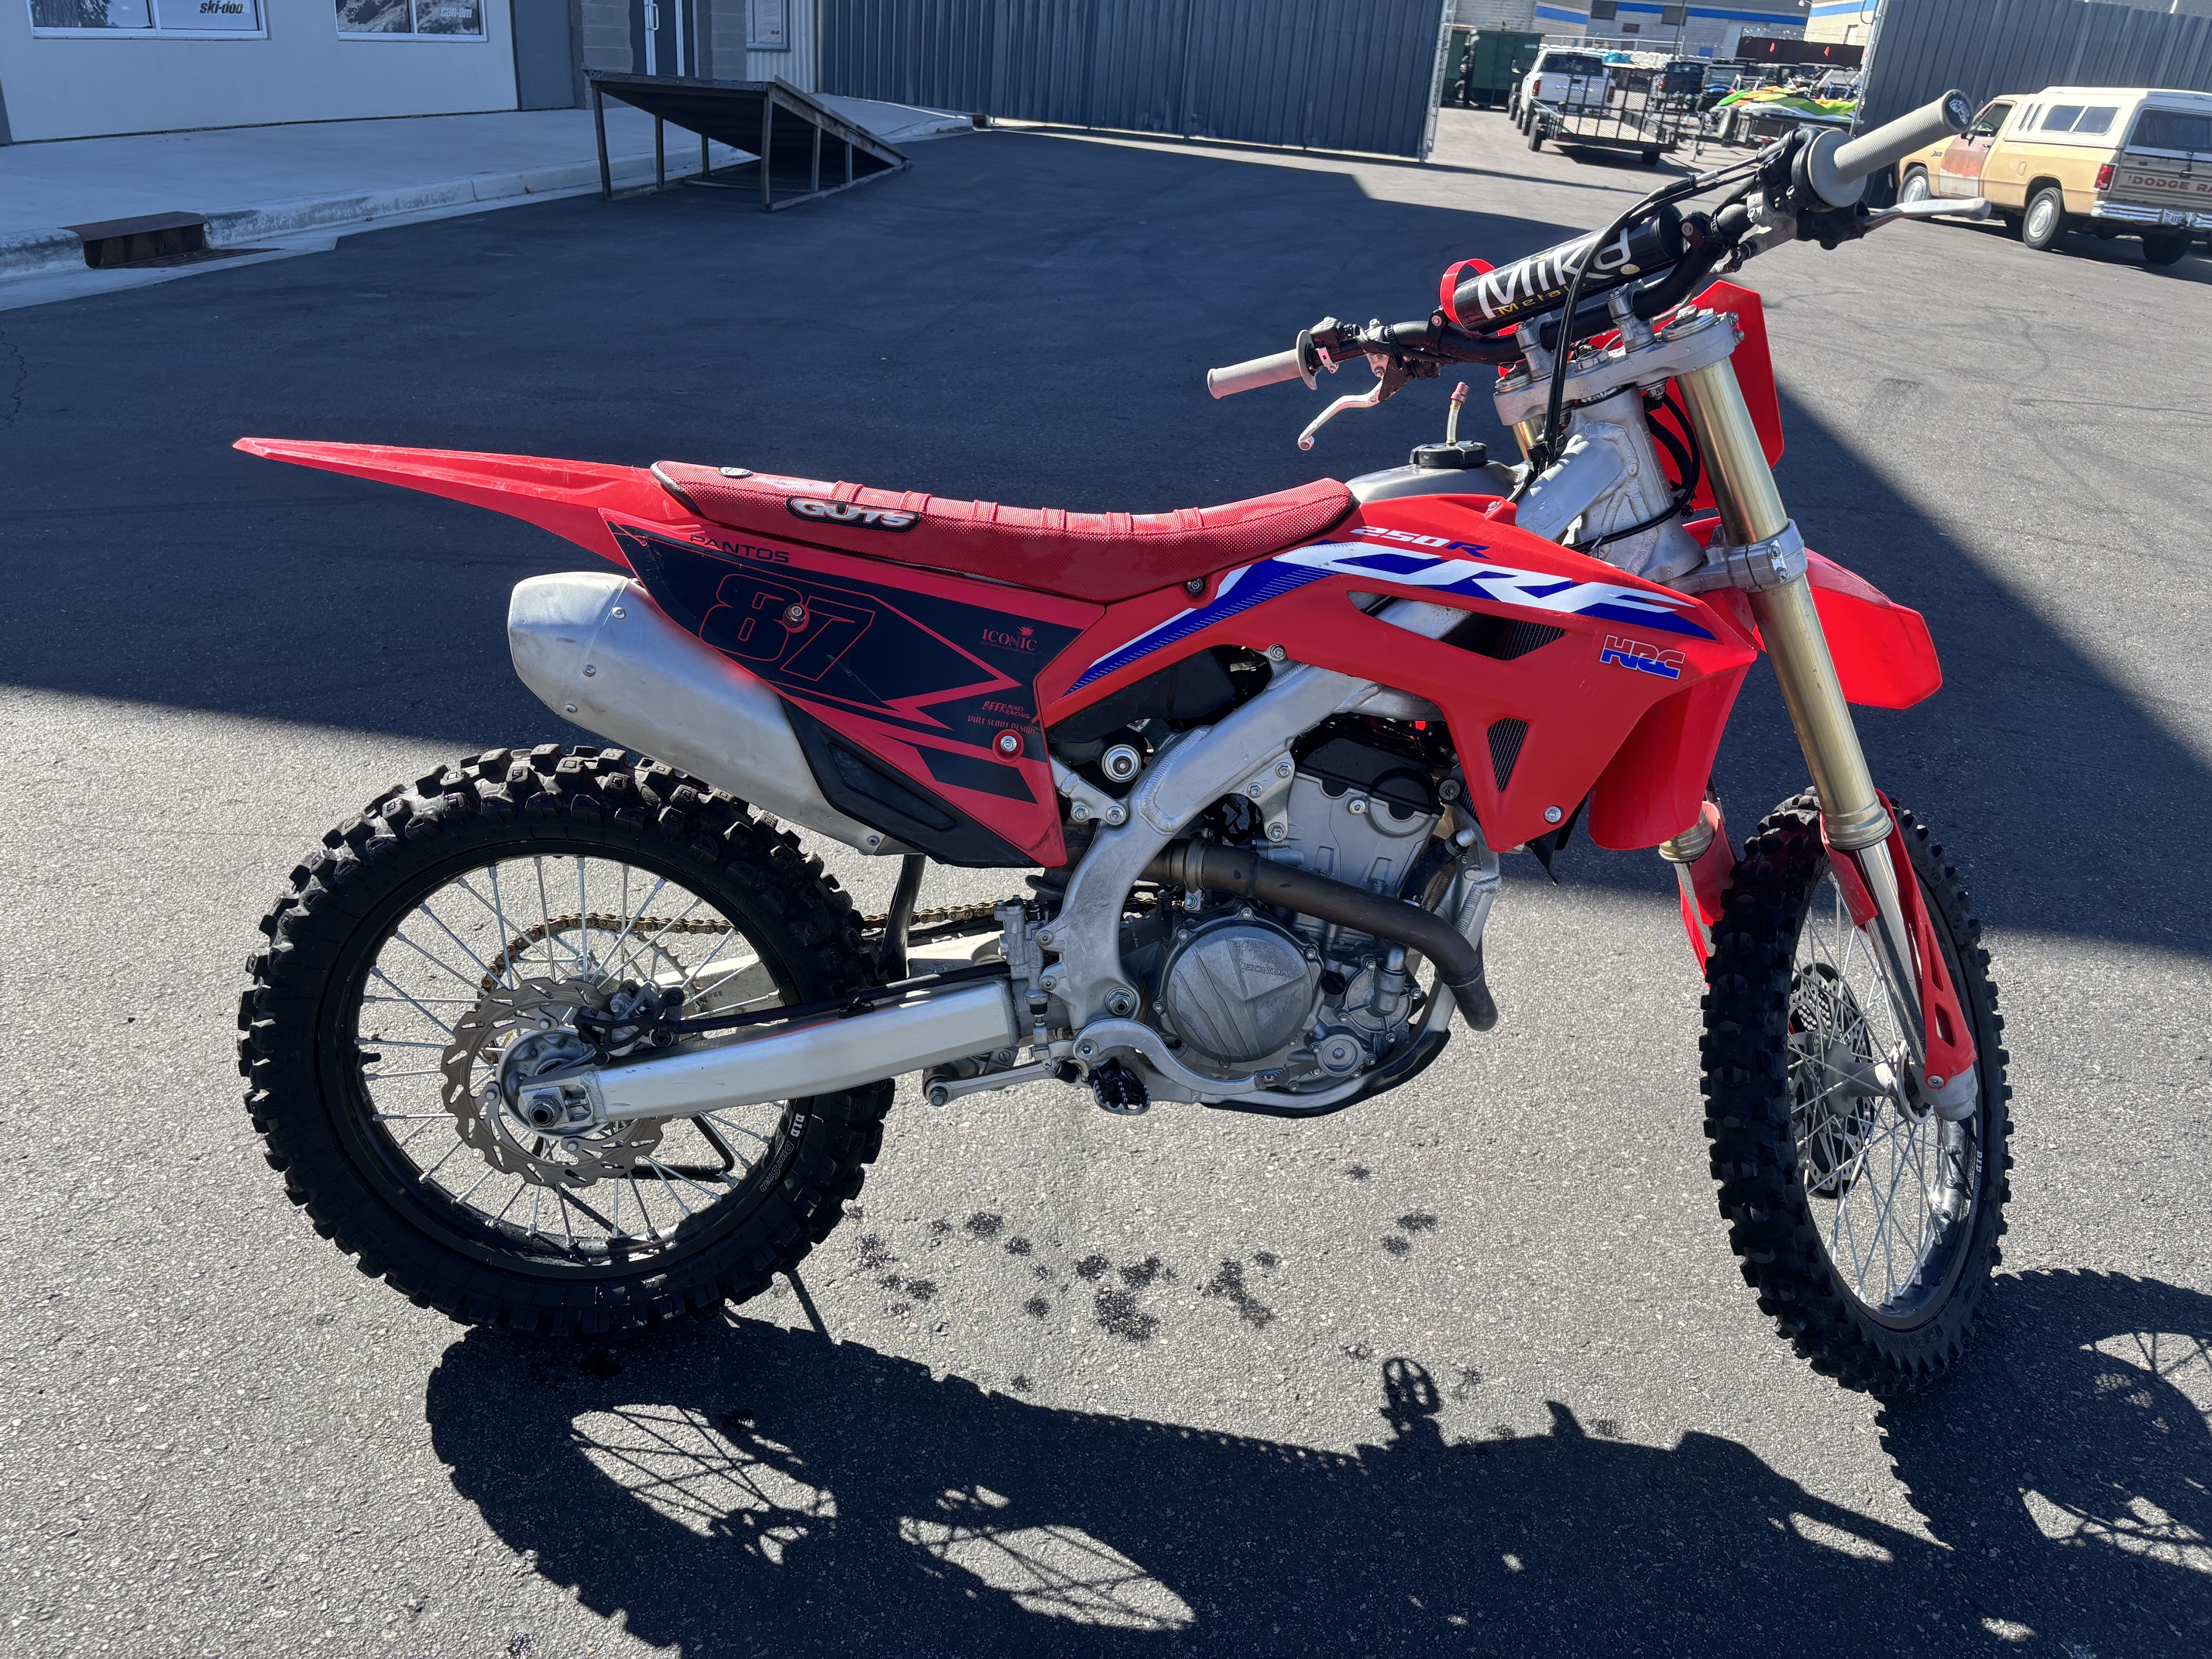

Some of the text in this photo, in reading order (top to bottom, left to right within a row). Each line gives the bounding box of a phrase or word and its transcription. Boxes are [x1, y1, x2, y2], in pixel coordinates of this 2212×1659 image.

[2132, 176, 2190, 190] DODGE
[791, 499, 916, 527] GUTS
[690, 534, 789, 563] PANTOS
[1273, 542, 1696, 613] CRF
[699, 573, 876, 682] 87
[982, 628, 1037, 651] ICONIC
[1599, 635, 1687, 680] HRC
[981, 700, 1007, 713] BEER
[967, 715, 985, 725] DIRT
[1242, 963, 1290, 977] HONDA
